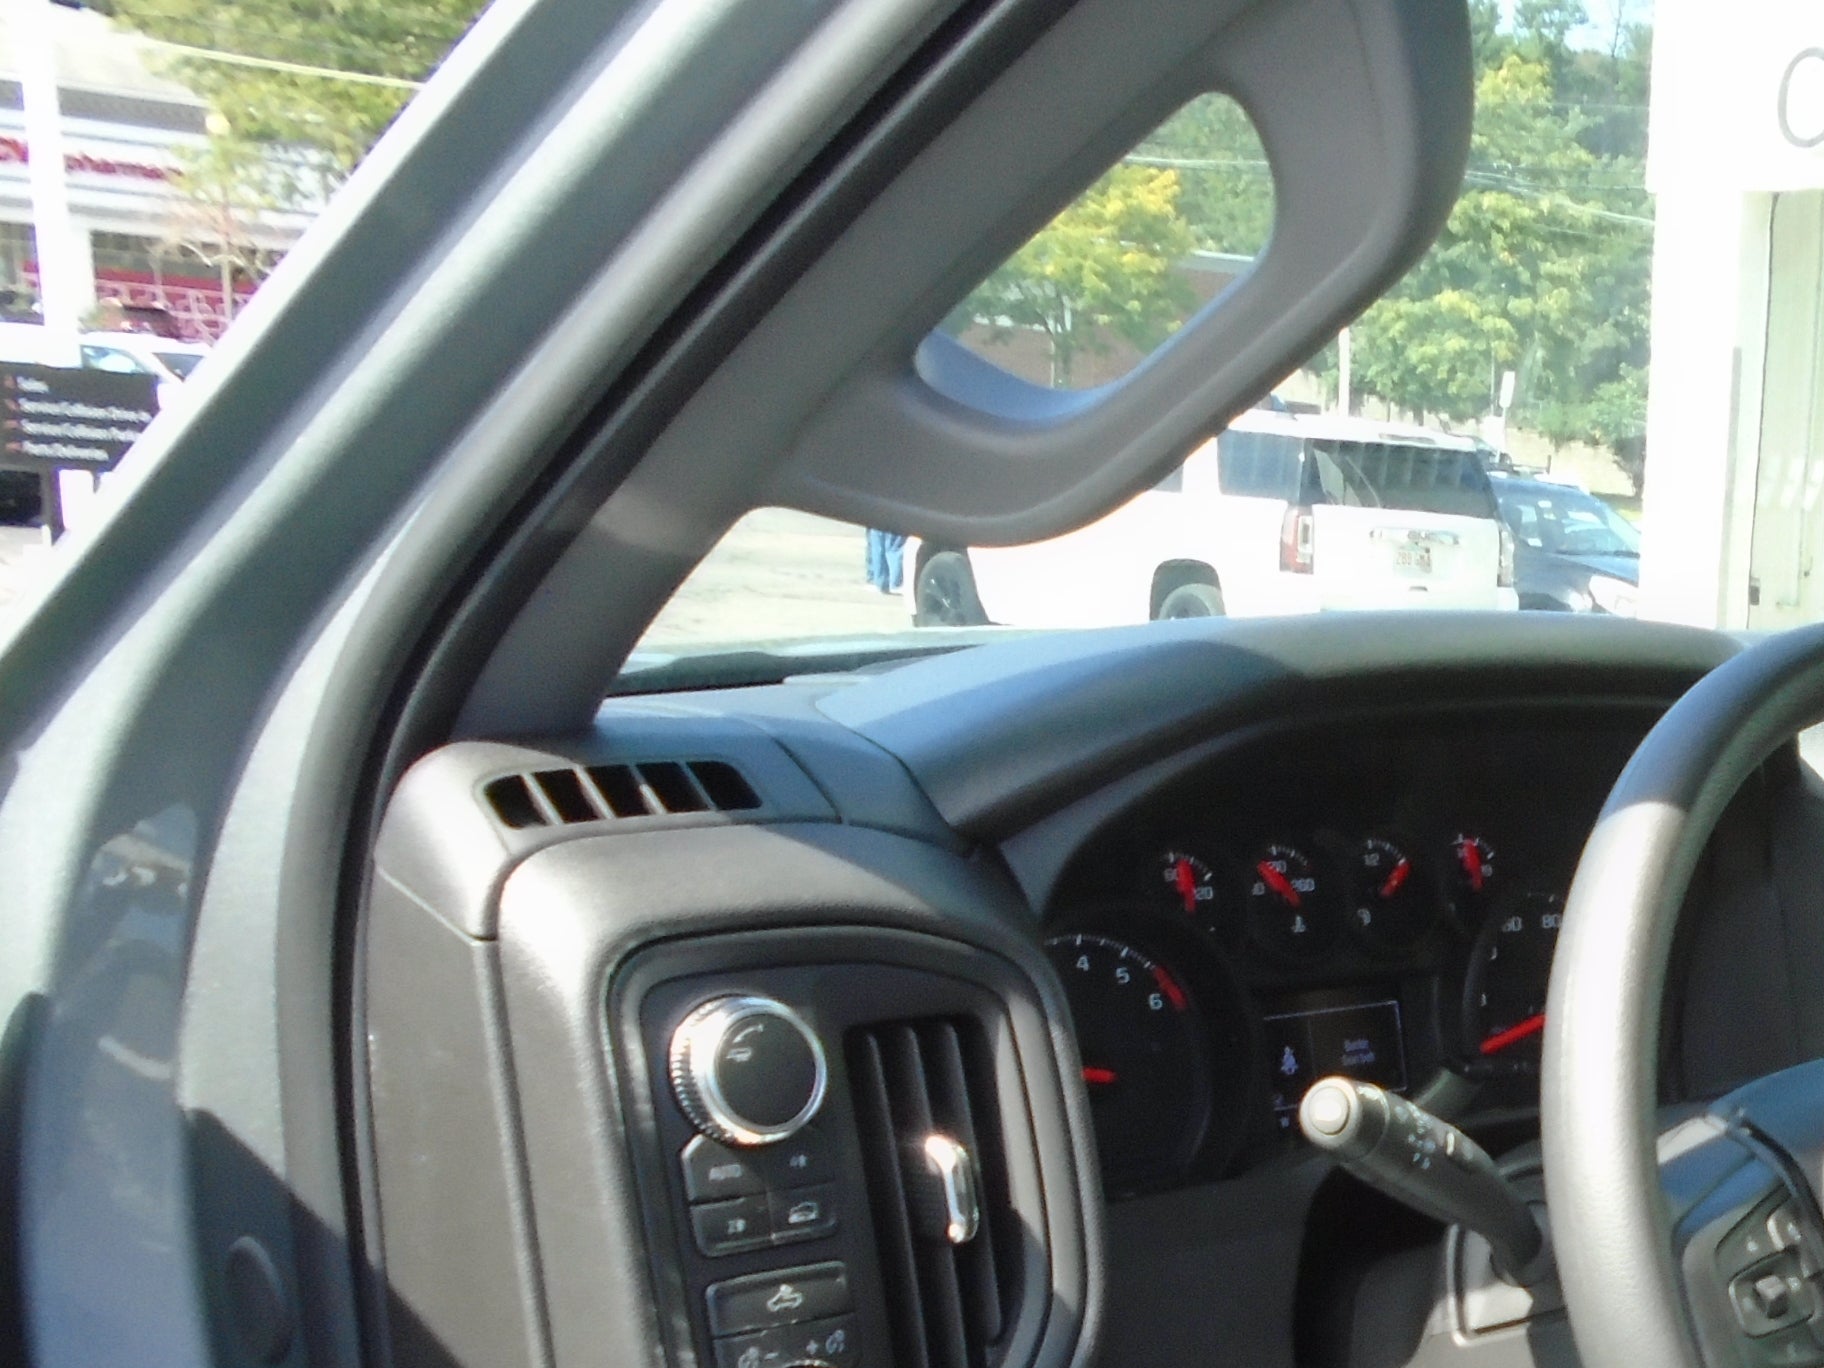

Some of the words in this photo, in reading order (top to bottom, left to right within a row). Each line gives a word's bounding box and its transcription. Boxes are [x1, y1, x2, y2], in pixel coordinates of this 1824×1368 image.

[1076, 954, 1090, 972] 4
[1115, 966, 1131, 984] 5
[1148, 992, 1163, 1011] 6
